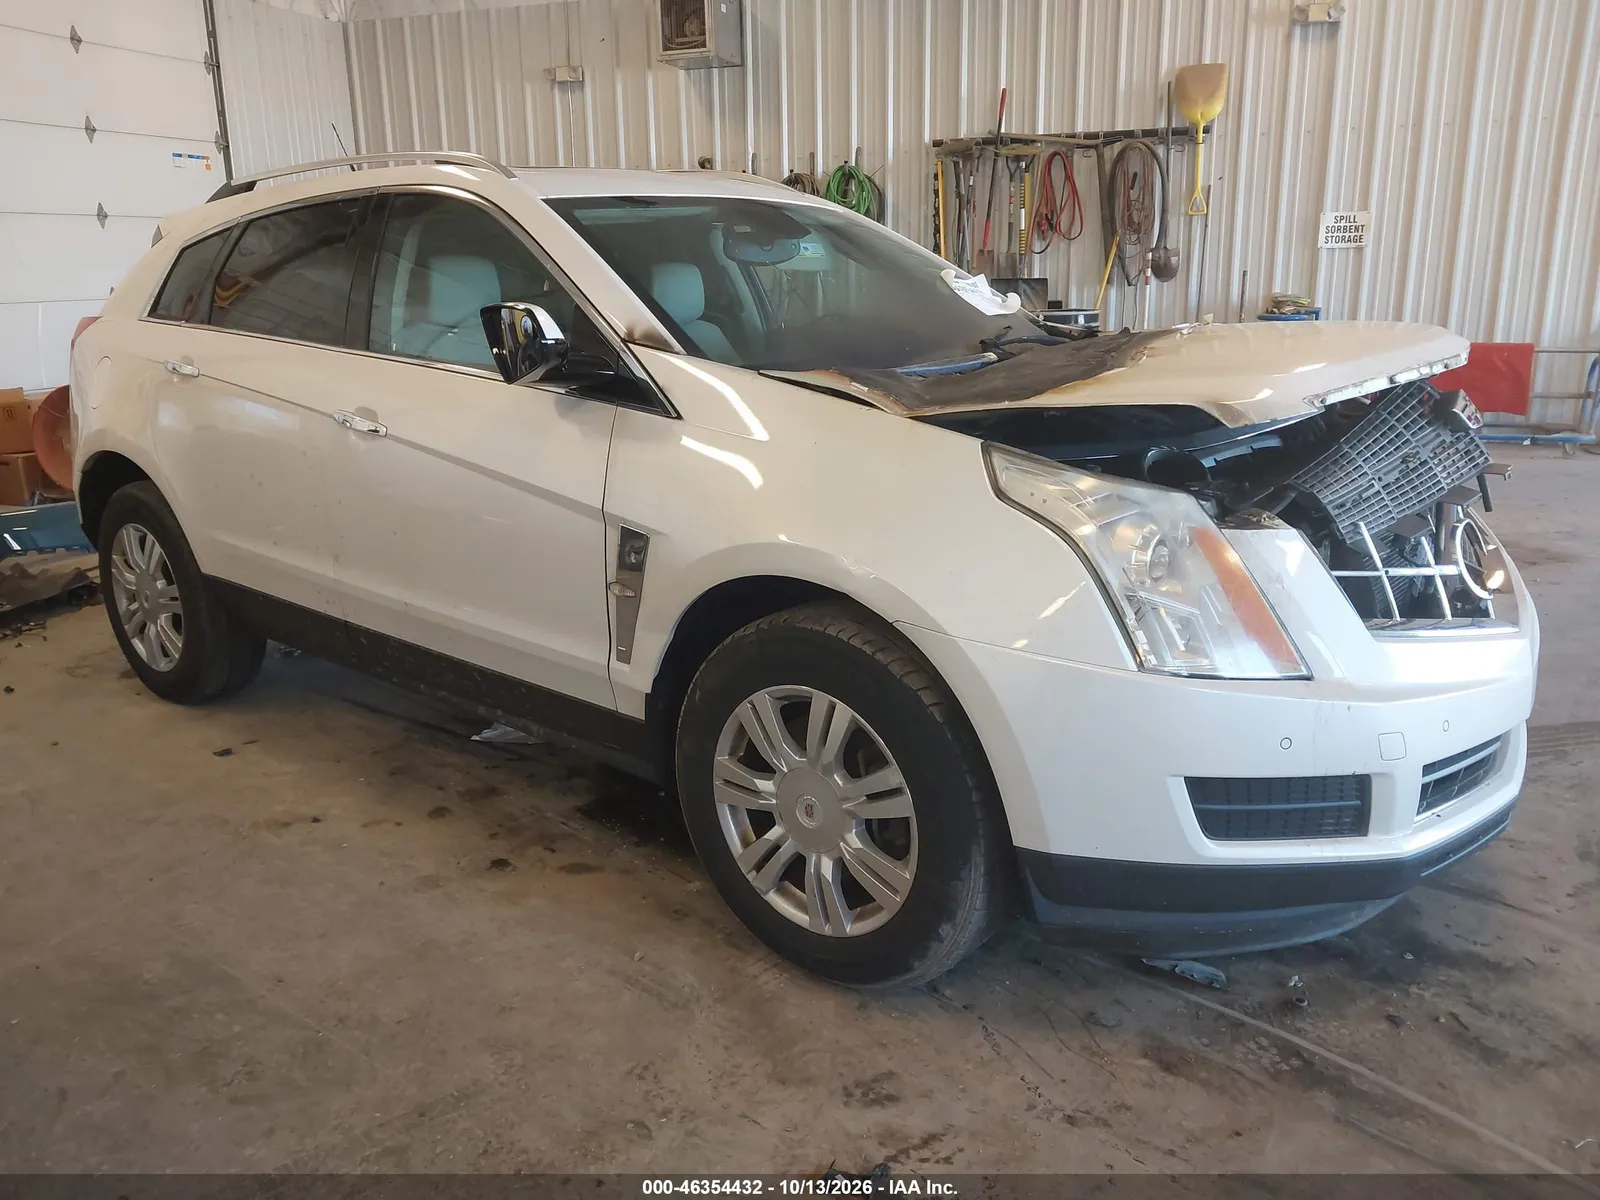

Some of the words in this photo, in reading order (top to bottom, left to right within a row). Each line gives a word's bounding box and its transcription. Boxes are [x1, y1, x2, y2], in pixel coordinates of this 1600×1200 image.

[1333, 214, 1358, 224] SPILL
[1325, 224, 1365, 234] SORBENT
[1324, 234, 1364, 244] STORAGE
